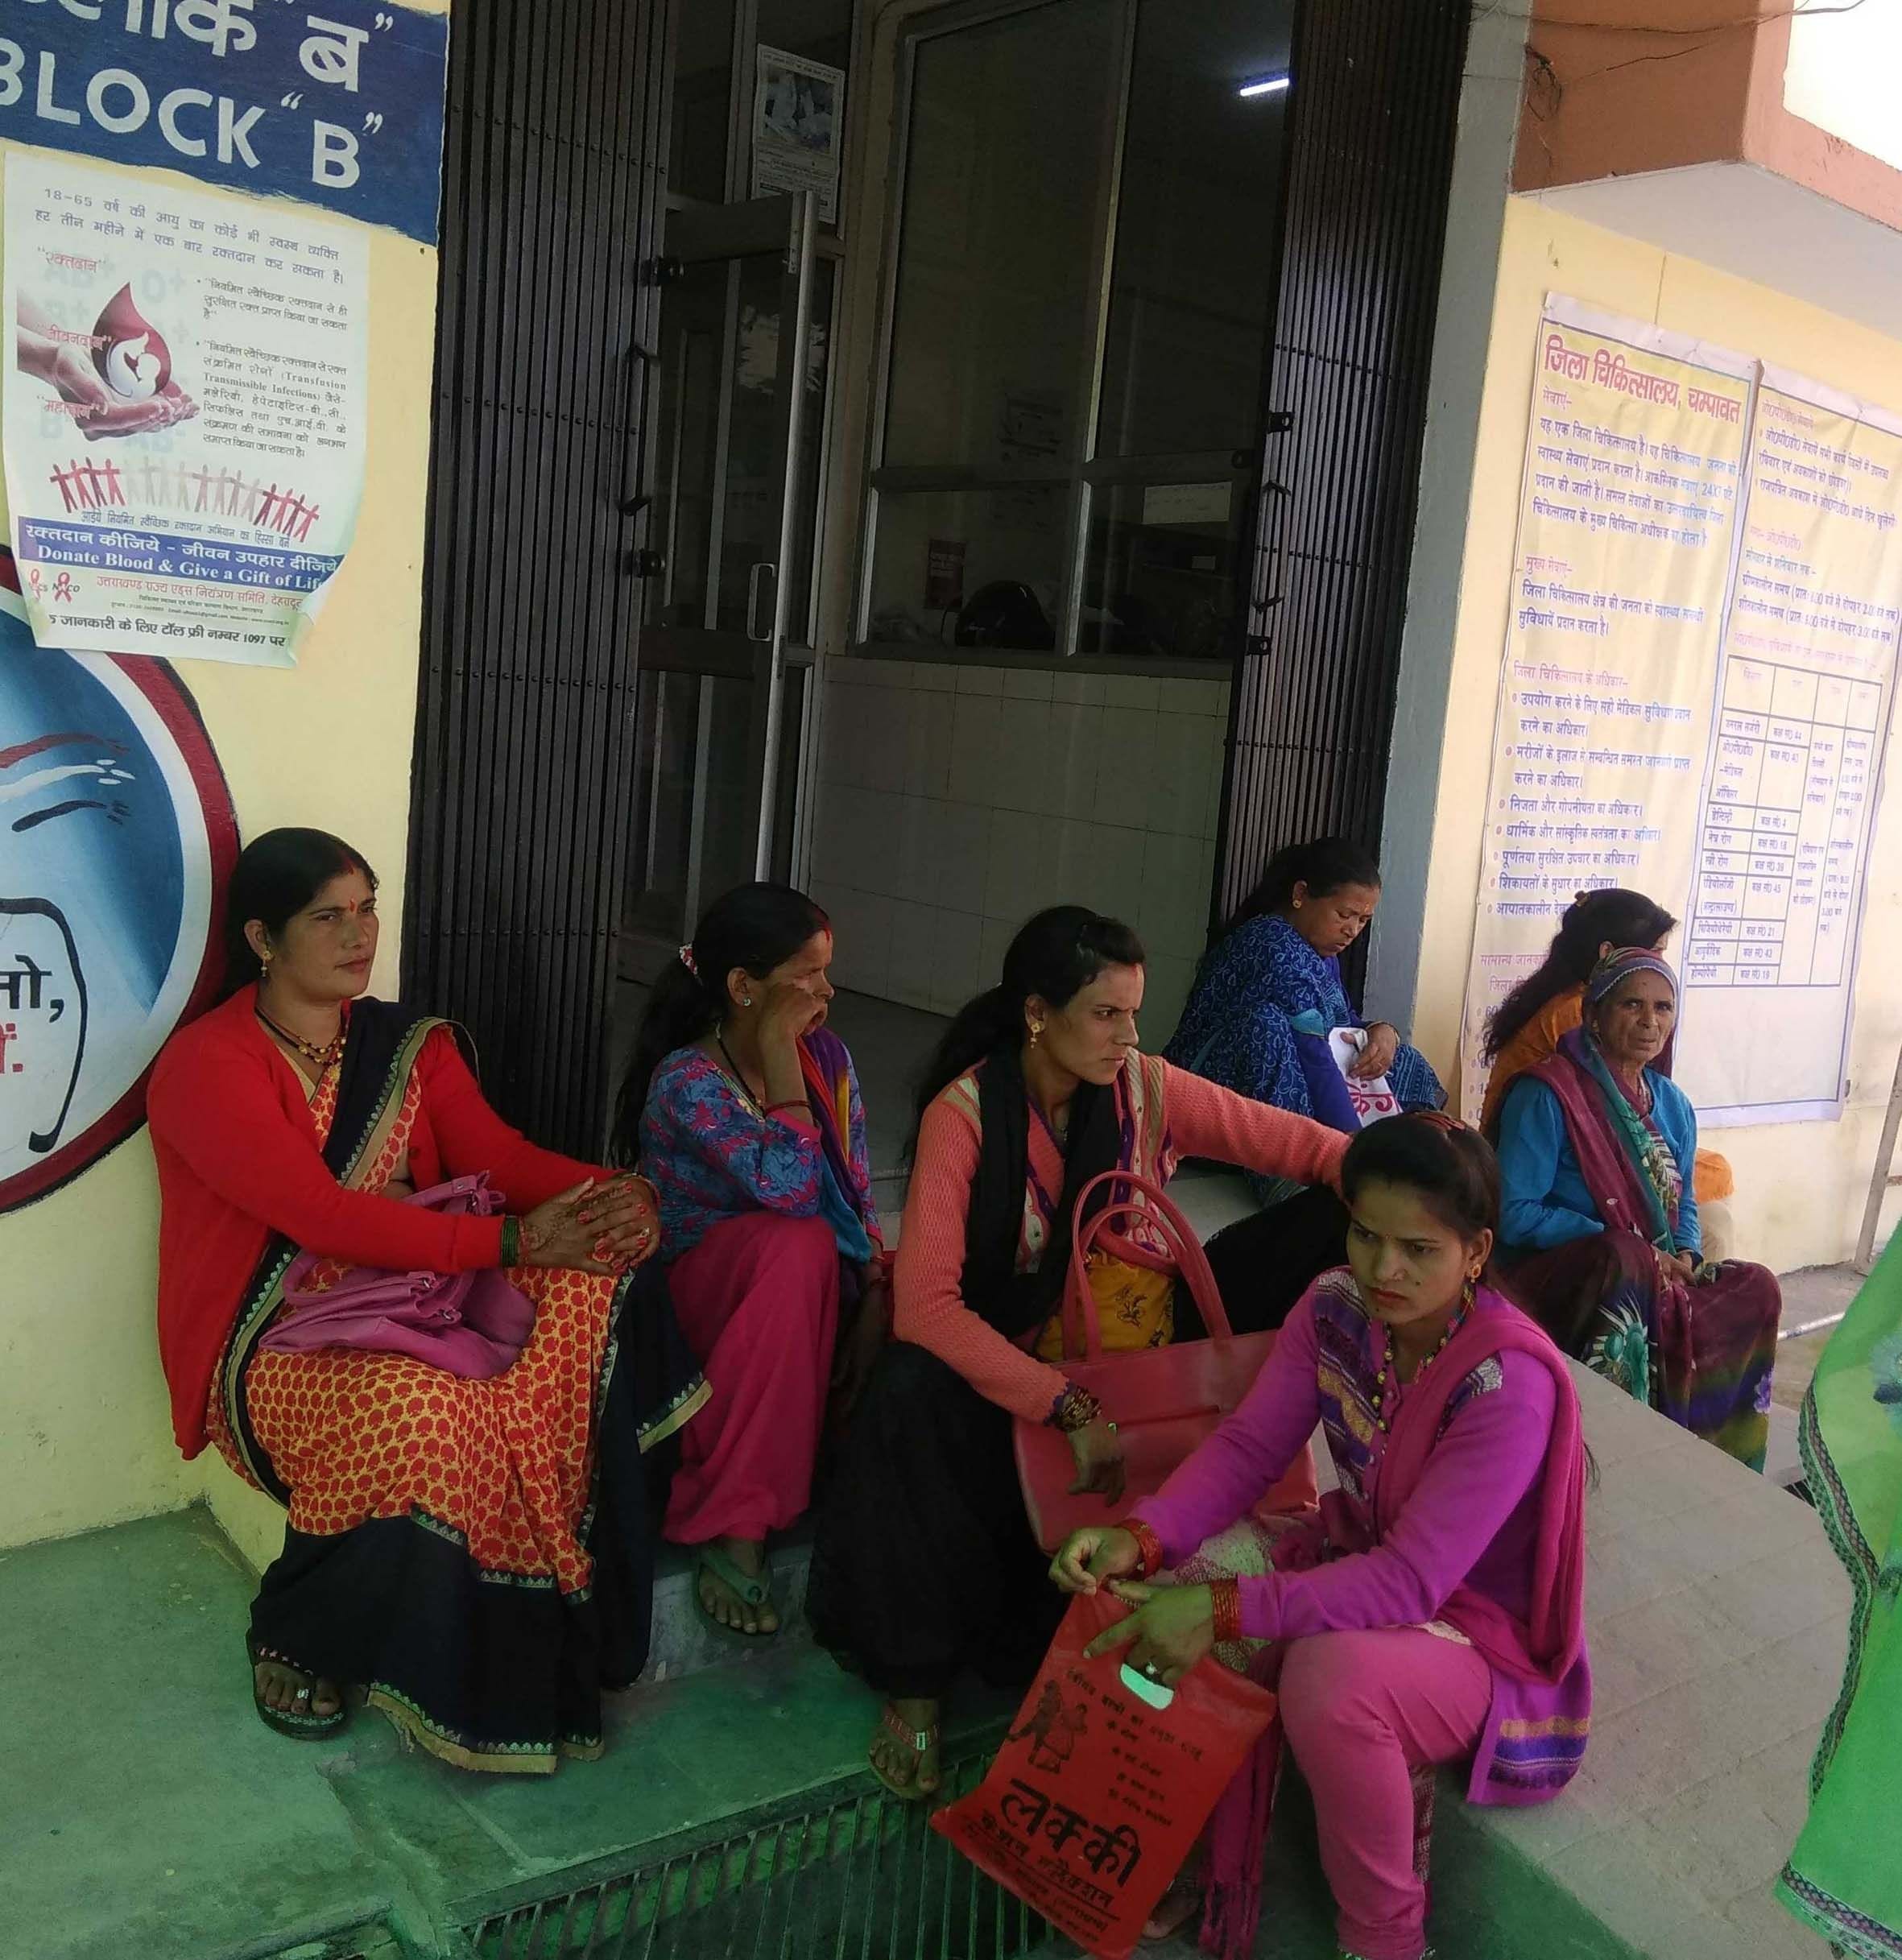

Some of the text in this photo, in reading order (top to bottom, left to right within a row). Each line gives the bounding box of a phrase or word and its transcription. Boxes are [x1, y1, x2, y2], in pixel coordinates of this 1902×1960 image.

[44, 188, 92, 208] 18-65
[130, 205, 146, 218] की
[156, 211, 180, 229] आयु
[189, 217, 205, 231] का
[214, 218, 238, 239] कोई
[247, 226, 259, 242] भी
[35, 209, 50, 224] हर
[61, 211, 83, 228] तीन
[94, 217, 124, 237] महीने
[135, 225, 143, 240] में
[155, 234, 174, 246] एक
[184, 240, 201, 253] बार
[213, 245, 255, 264] रक्तदान
[265, 257, 283, 271] कर
[292, 263, 323, 279] सकता
[284, 309, 304, 322] किया
[308, 315, 317, 325] जा
[326, 302, 334, 315] से
[338, 305, 347, 316] ही
[204, 372, 267, 391] Transmissible
[1544, 334, 1589, 381] जिला
[1592, 349, 1681, 411] चिकित्सालय,
[1687, 387, 1742, 424] चम्पावत
[242, 422, 254, 433] की
[1540, 417, 1552, 432] यह
[1555, 420, 1570, 436] एक
[1573, 420, 1592, 443] जिला
[1558, 476, 1569, 493] की
[1572, 479, 1592, 497] जाती
[26, 524, 93, 544] रक्तदान
[99, 531, 160, 552] कीजिये
[181, 542, 231, 561] जीवन
[235, 550, 284, 569] उपहार
[39, 545, 100, 564] Donate
[105, 552, 153, 570] Blood
[159, 560, 173, 573] &
[180, 561, 219, 578] Give
[223, 571, 233, 580] a
[238, 569, 271, 585] Gift
[275, 573, 292, 587] of
[1522, 578, 1546, 599] जिला
[60, 613, 114, 630] जानकारी
[121, 618, 131, 631] के
[136, 618, 158, 634] लिए
[163, 622, 184, 636] टॉल
[188, 624, 204, 639] फ्री
[208, 628, 241, 643] नम्बर
[244, 633, 266, 644] 1097
[270, 635, 286, 647] पर
[1542, 721, 1553, 734] का
[1536, 772, 1547, 786] का
